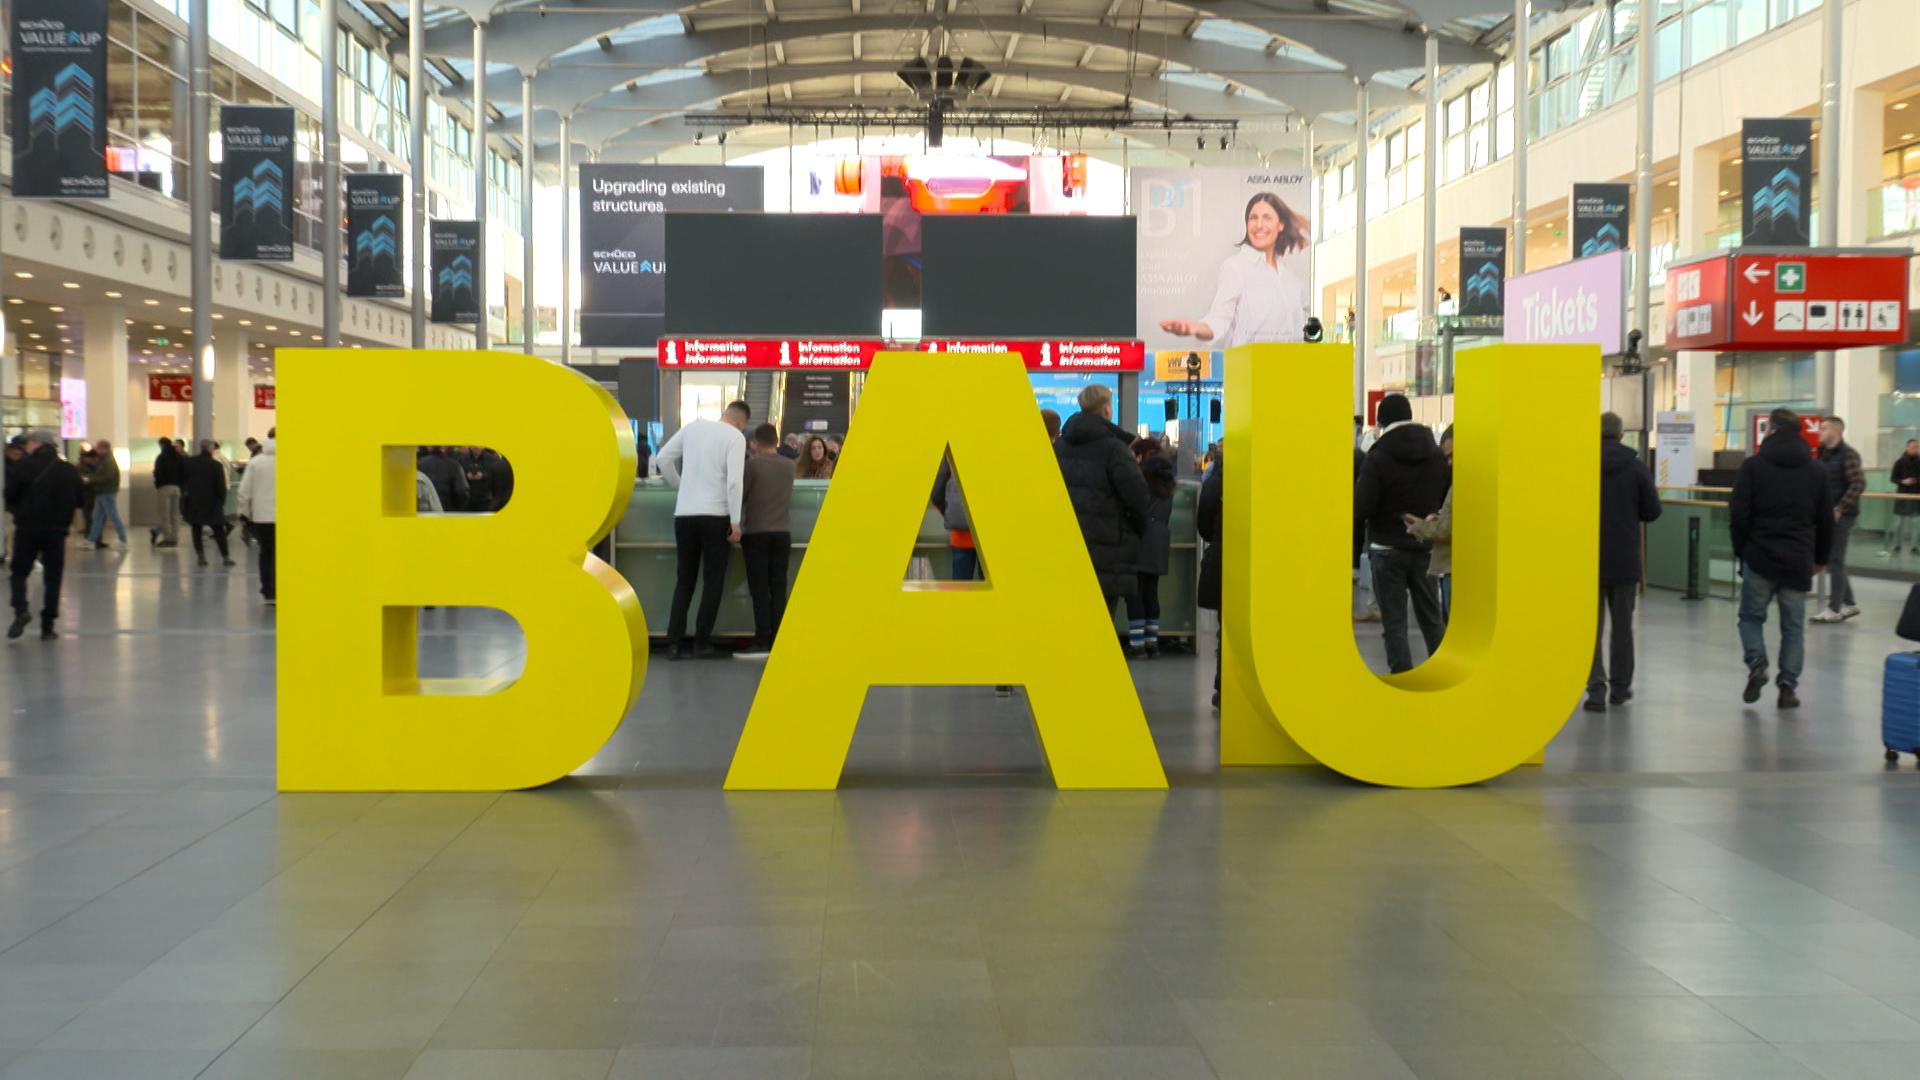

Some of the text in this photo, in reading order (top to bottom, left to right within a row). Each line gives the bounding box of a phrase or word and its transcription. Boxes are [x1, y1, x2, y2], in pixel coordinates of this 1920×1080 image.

[20, 32, 102, 46] VALUE UP
[592, 178, 726, 198] Upgrading existing
[592, 249, 637, 259] SCHÜCO
[593, 261, 639, 274] VALUE
[1522, 286, 1598, 343] Tickets
[684, 340, 747, 352] Information
[798, 341, 861, 353] Information
[946, 341, 1008, 353] Information
[1059, 342, 1121, 354] Information
[684, 353, 747, 365] Information
[798, 354, 861, 366] Information
[1059, 354, 1121, 366] Information
[275, 343, 1601, 791] BAU
